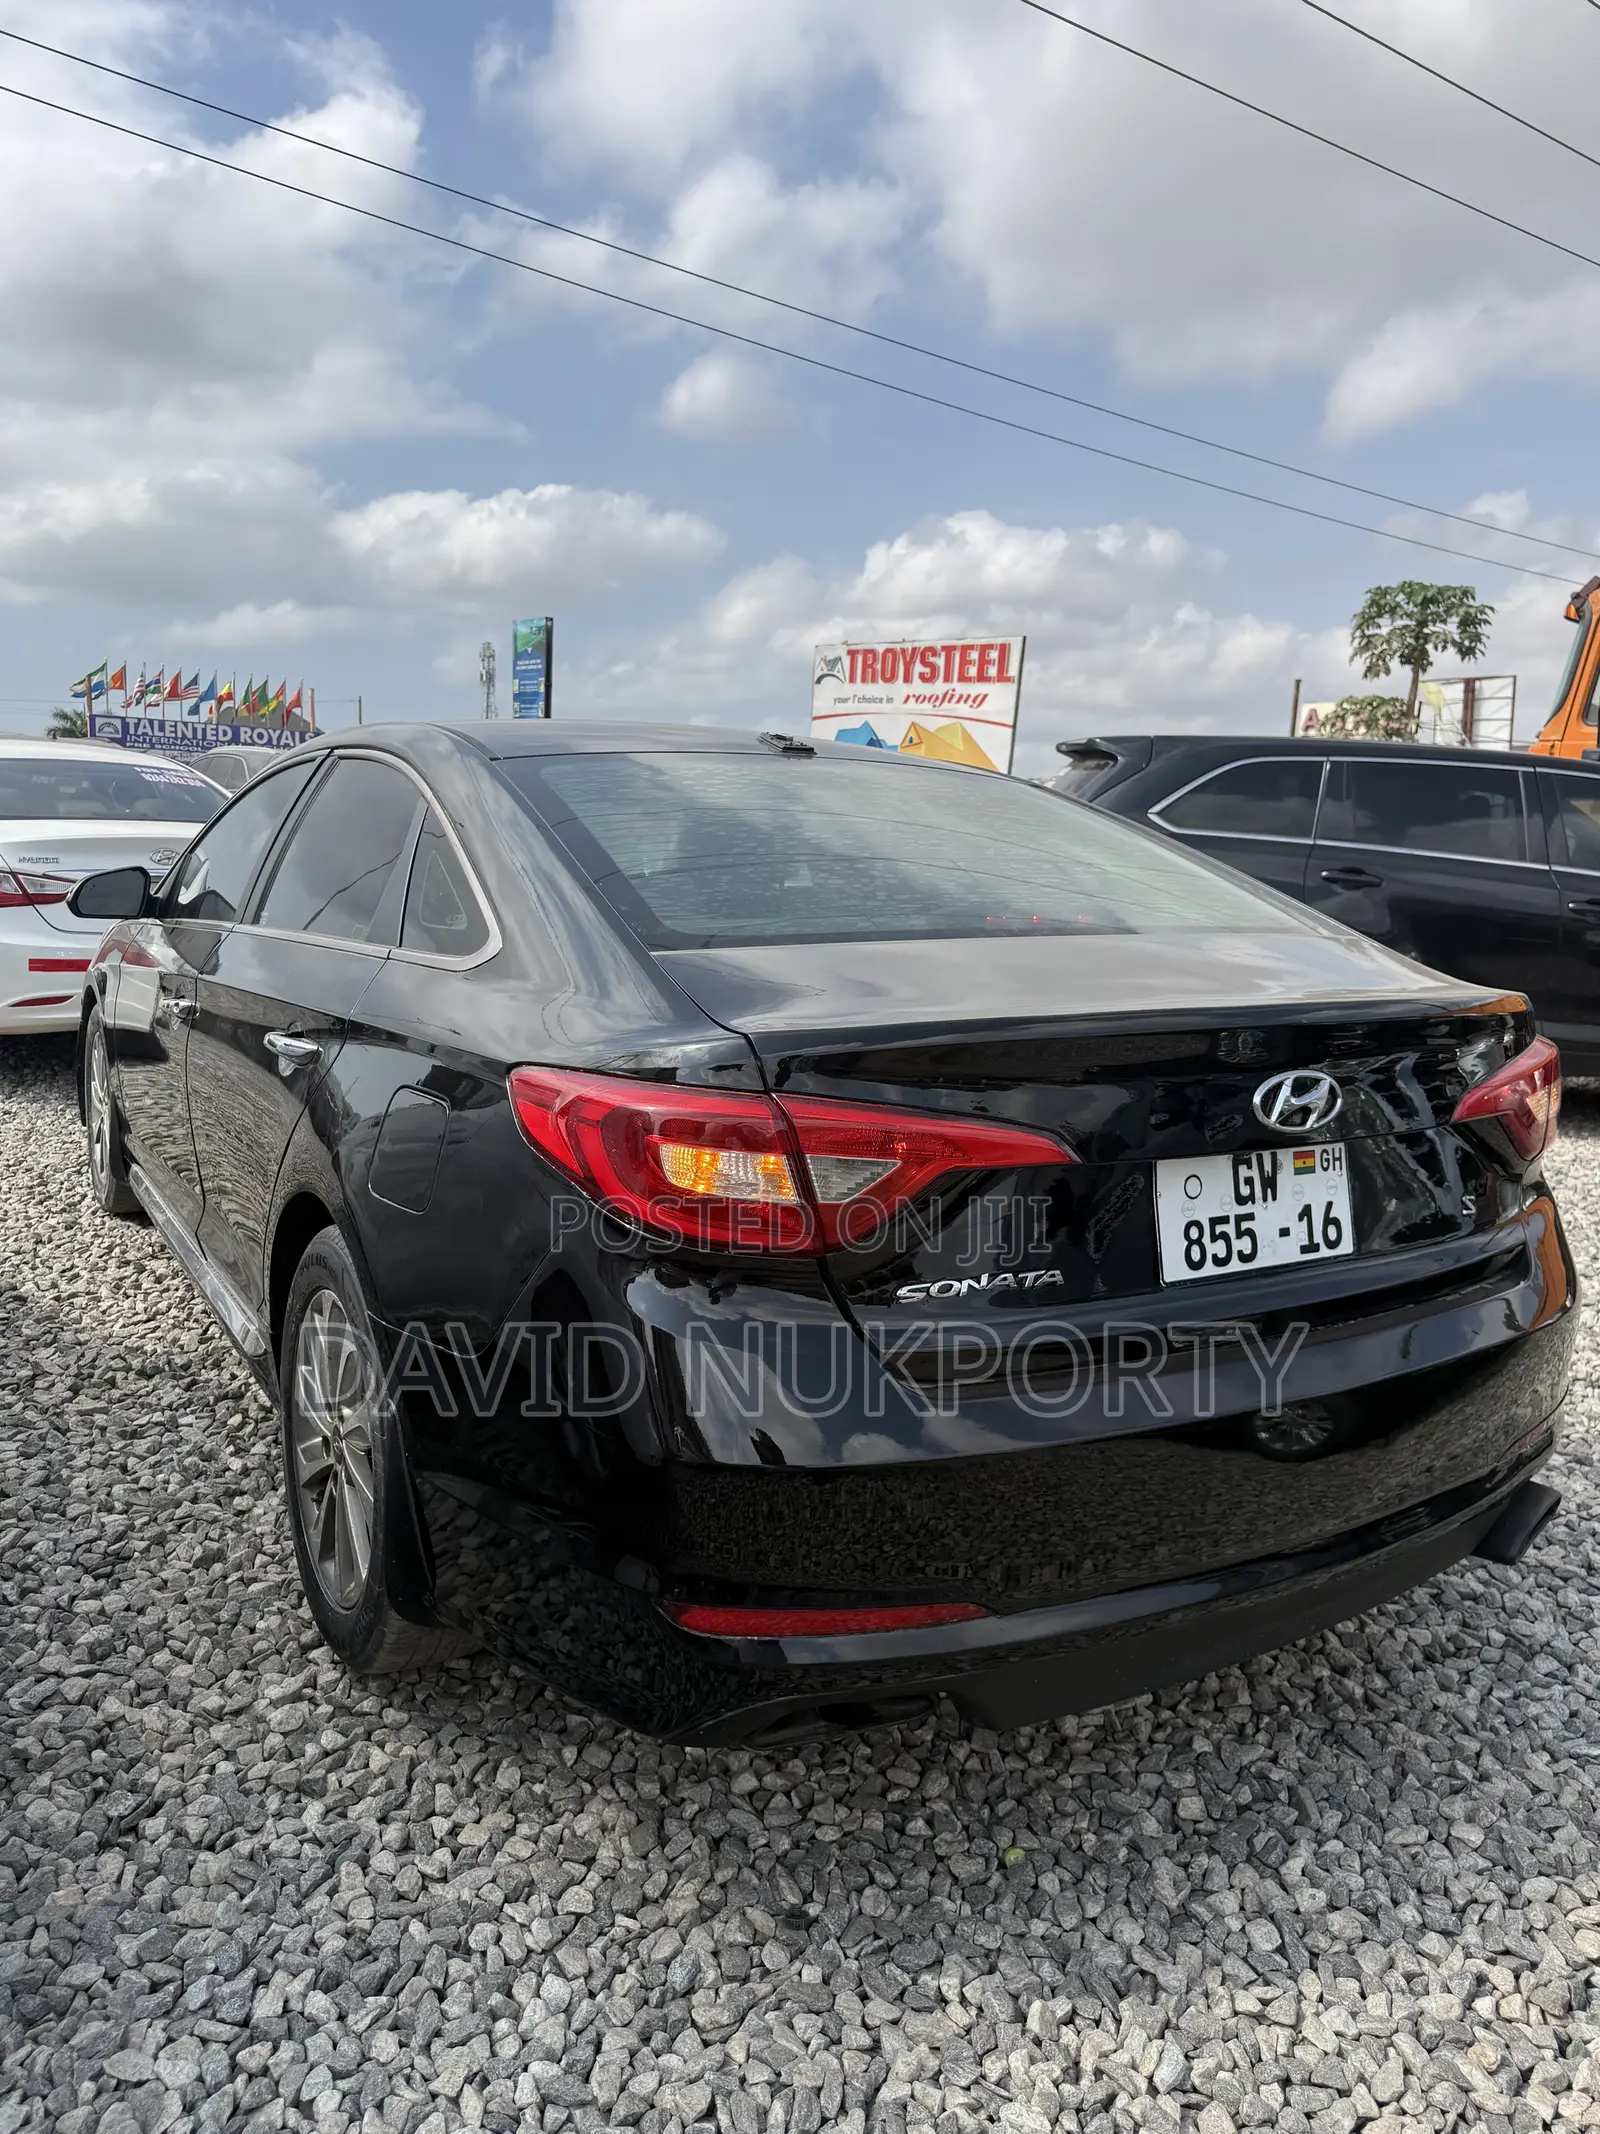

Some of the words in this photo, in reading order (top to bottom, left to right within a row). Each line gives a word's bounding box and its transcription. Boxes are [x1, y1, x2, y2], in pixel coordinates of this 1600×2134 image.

[846, 643, 1014, 684] TROYSTEEL
[833, 696, 851, 706] your
[885, 695, 894, 704] in
[902, 688, 989, 709] roofing
[125, 717, 232, 742] TALENTED
[1232, 1151, 1278, 1206] GW
[1320, 1147, 1343, 1172] GH
[1184, 1212, 1258, 1271] 855
[896, 1269, 1065, 1304] SONATA
